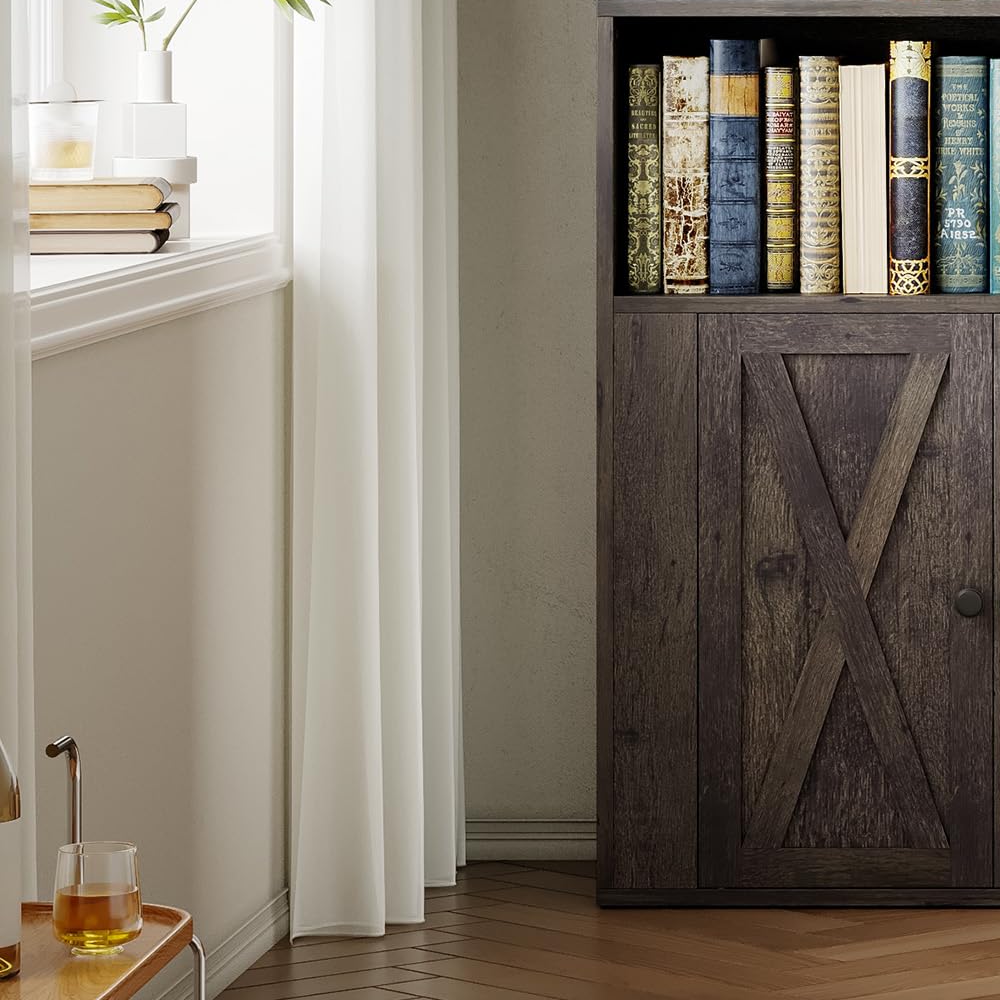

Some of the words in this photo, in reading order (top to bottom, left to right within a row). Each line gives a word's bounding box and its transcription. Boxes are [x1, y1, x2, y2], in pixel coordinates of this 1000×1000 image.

[941, 93, 978, 102] POETICAL
[942, 103, 975, 112] WORKS
[944, 136, 974, 145] HENRY
[944, 207, 966, 218] PR
[944, 219, 972, 228] 5790
